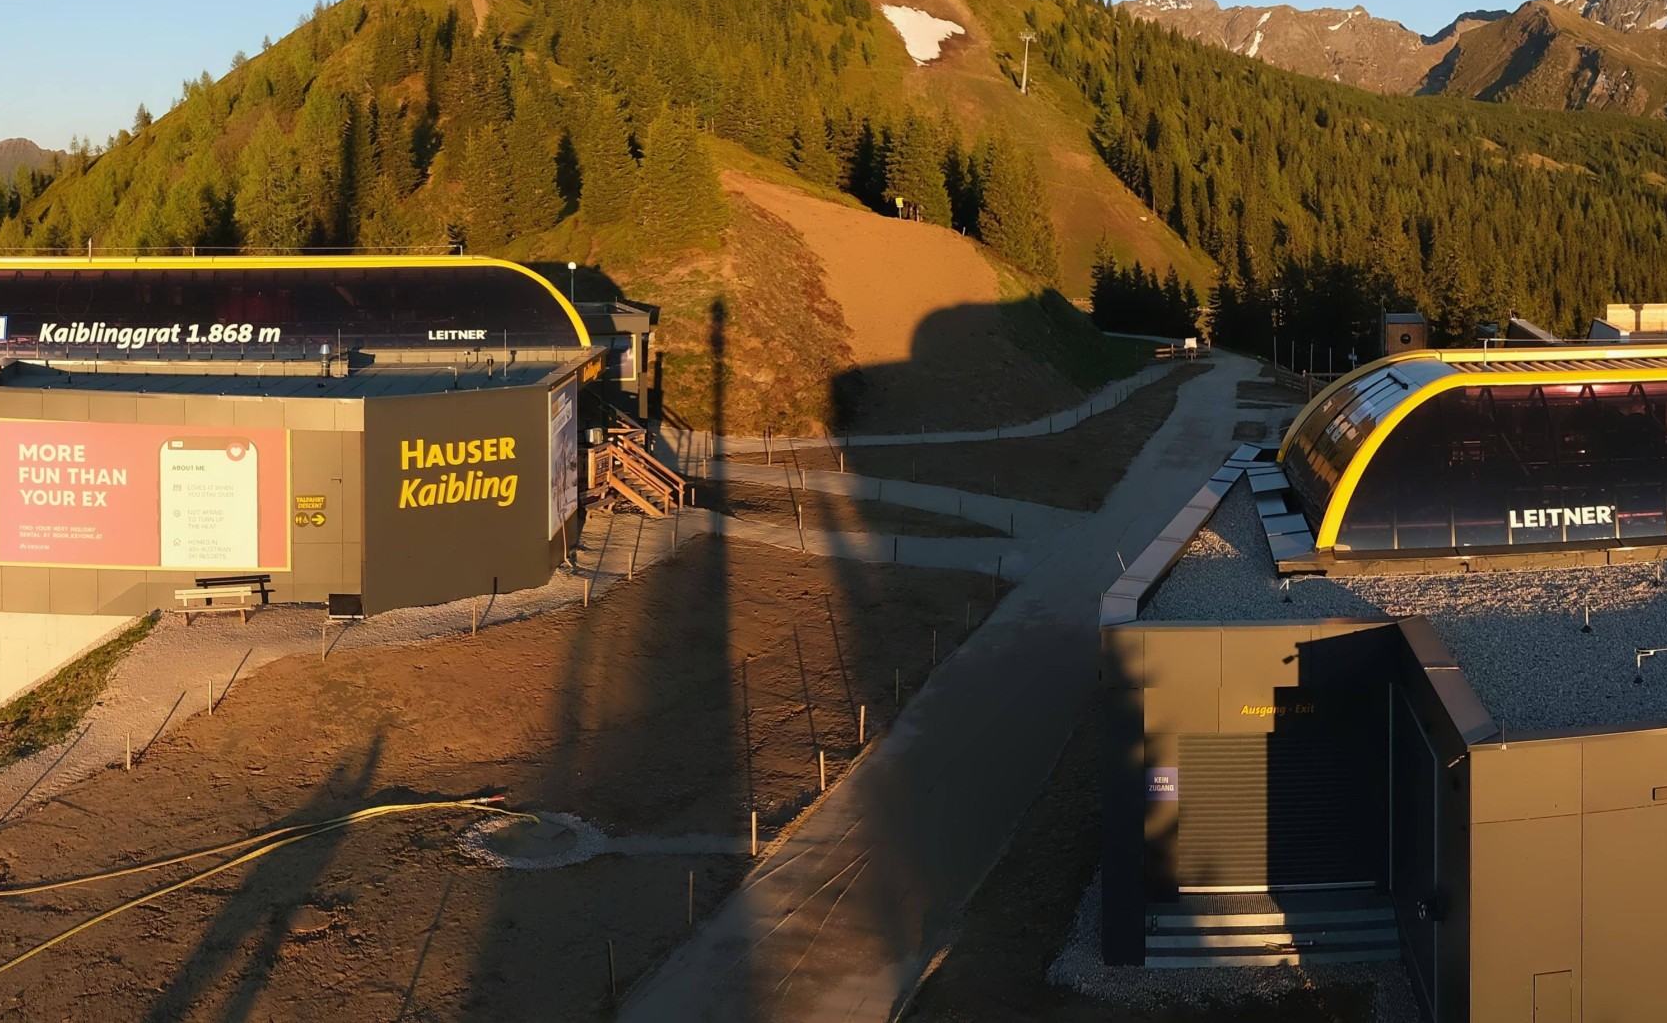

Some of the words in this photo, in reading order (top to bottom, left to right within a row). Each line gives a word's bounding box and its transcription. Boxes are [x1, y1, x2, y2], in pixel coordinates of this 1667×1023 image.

[39, 322, 181, 349] Kaiblinggrat
[185, 323, 254, 343] 1.868
[258, 327, 281, 343] m
[428, 330, 486, 341] LEITNER
[18, 443, 86, 463] MORE
[400, 437, 517, 470] HAUSER
[18, 466, 61, 484] FUN
[67, 468, 128, 486] THAN
[20, 489, 76, 507] YOUR
[82, 490, 108, 508] EX
[398, 471, 518, 509] Kaibling
[1509, 506, 1613, 528] LEITNER
[1240, 704, 1286, 717] Ausgang
[1295, 703, 1315, 714] Exit
[1148, 784, 1175, 792] ZUGANG
[1154, 776, 1169, 784] KEIN
